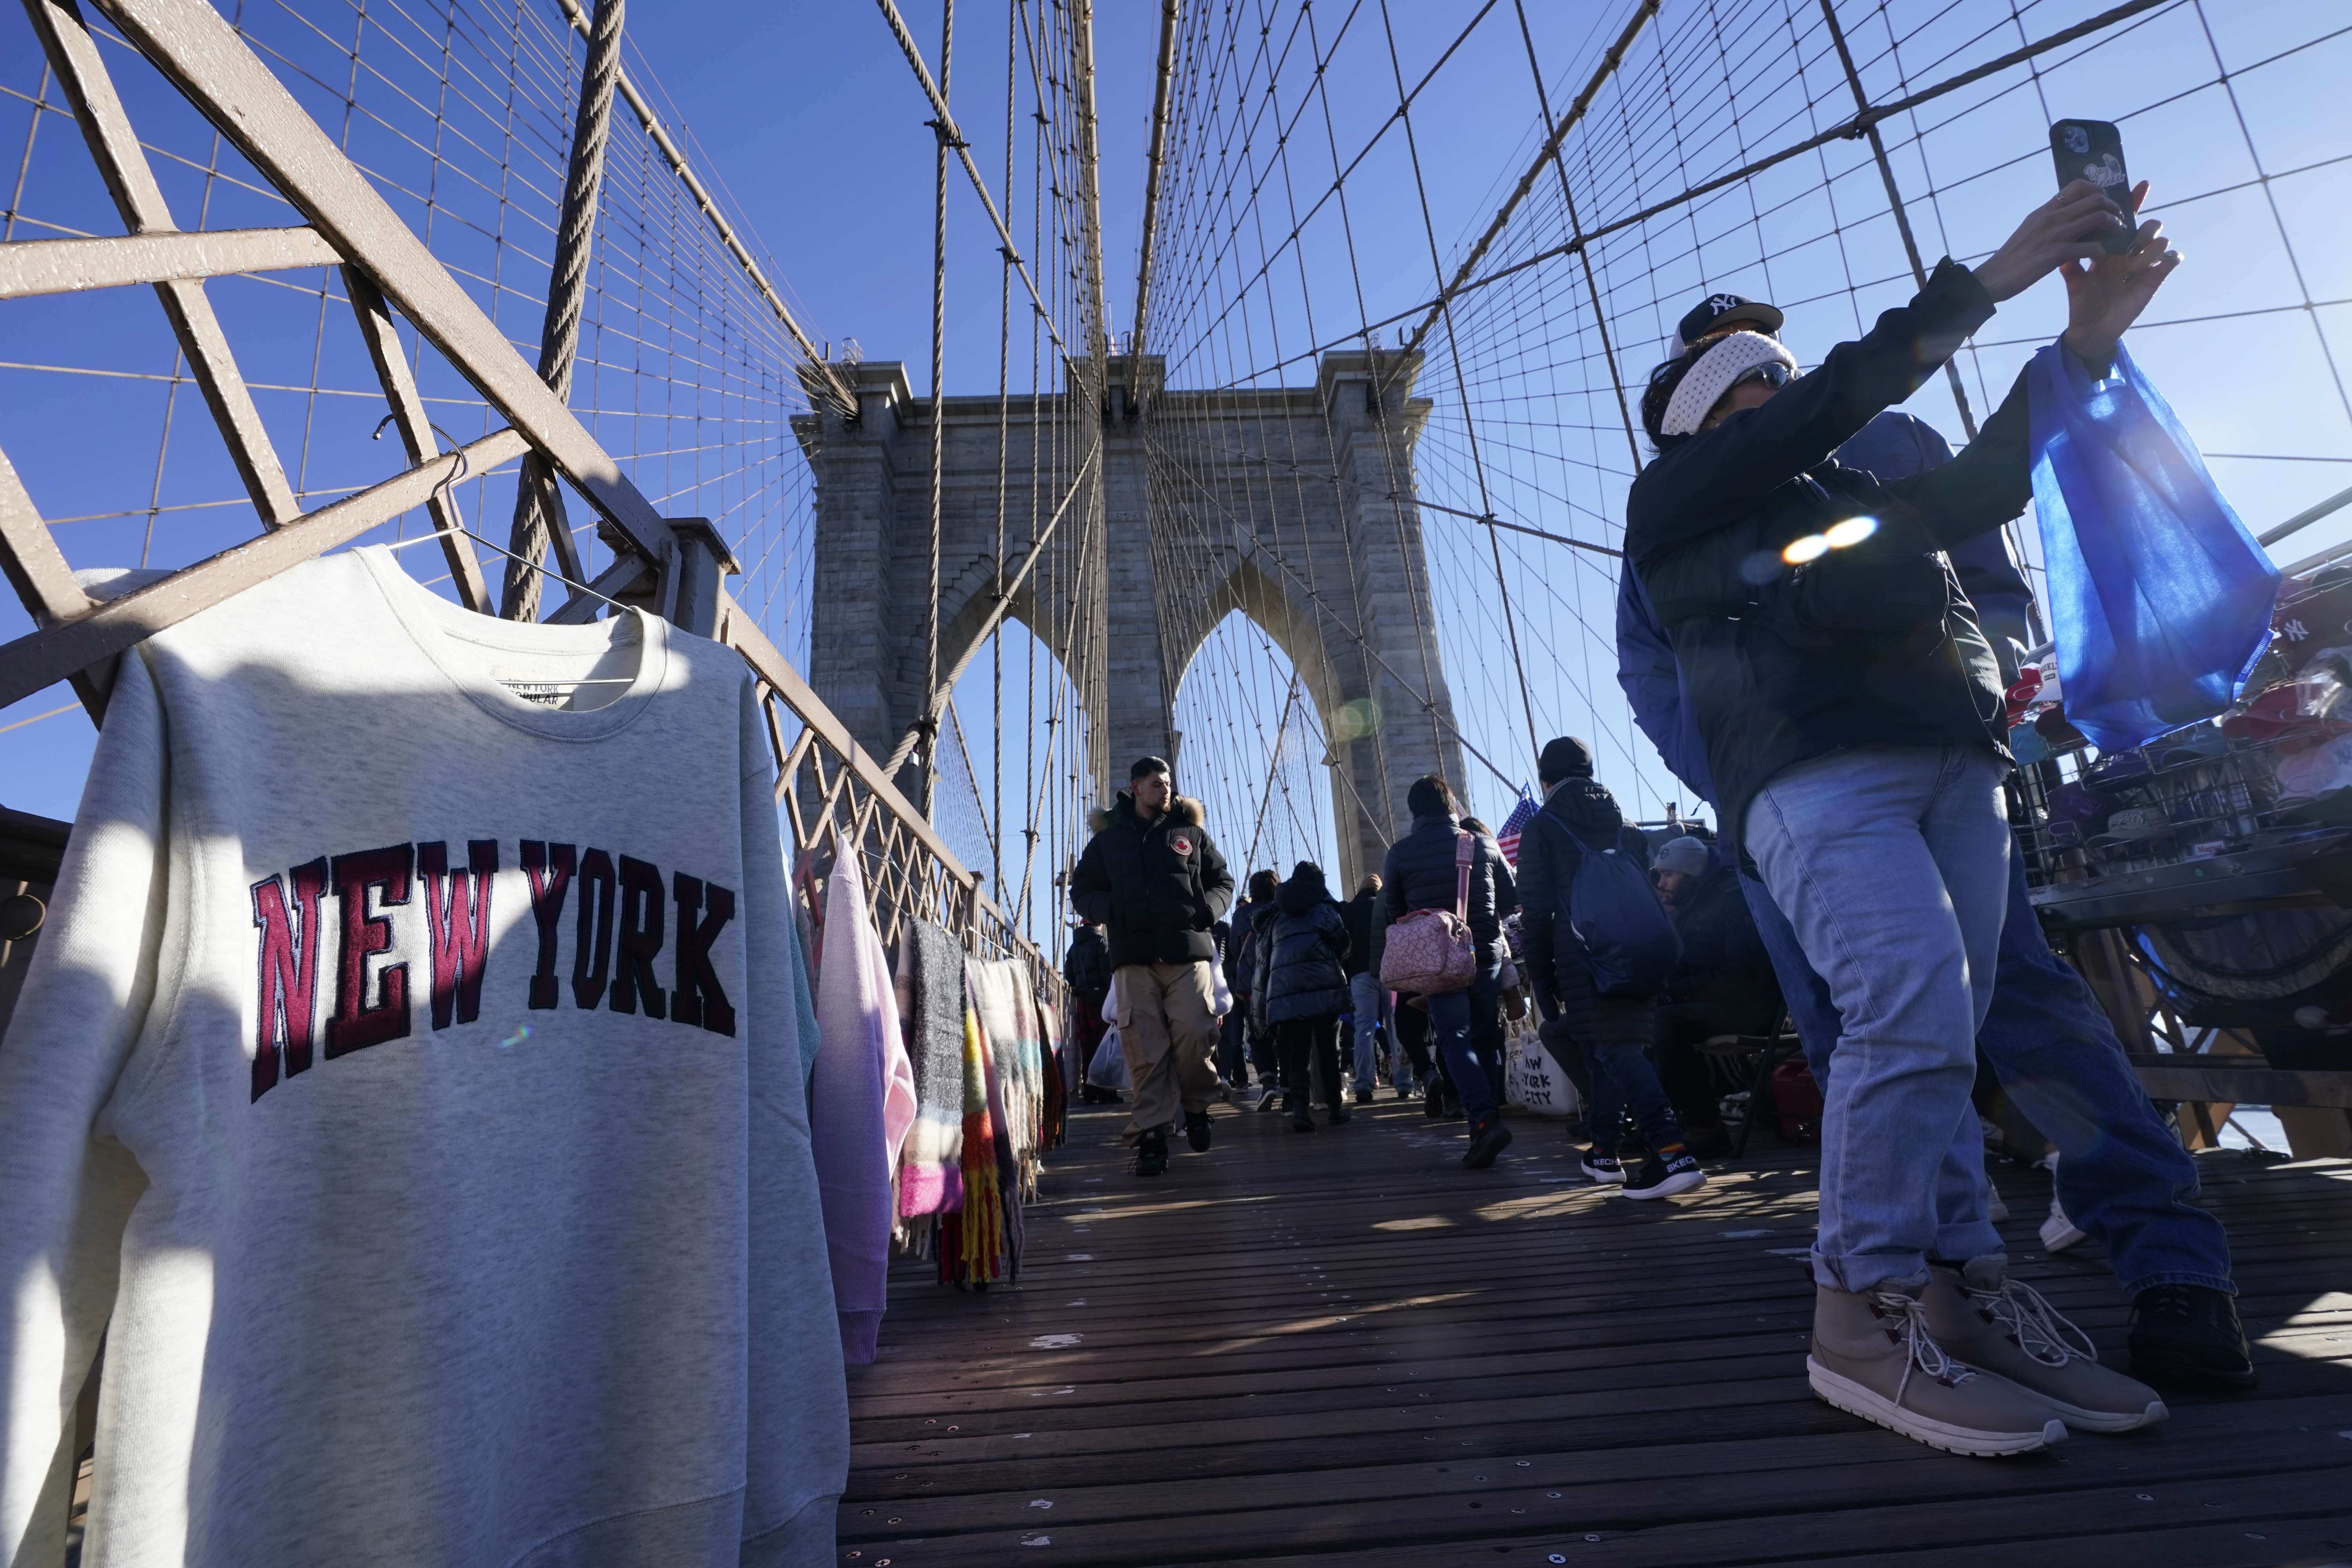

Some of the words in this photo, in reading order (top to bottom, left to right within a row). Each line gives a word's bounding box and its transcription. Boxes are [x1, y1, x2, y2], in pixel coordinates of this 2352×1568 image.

[1710, 294, 1737, 315] NY
[2284, 619, 2309, 641] NY
[250, 839, 499, 1104] NEW
[520, 840, 735, 1037] YORK
[1506, 1050, 1523, 1058] ORK
